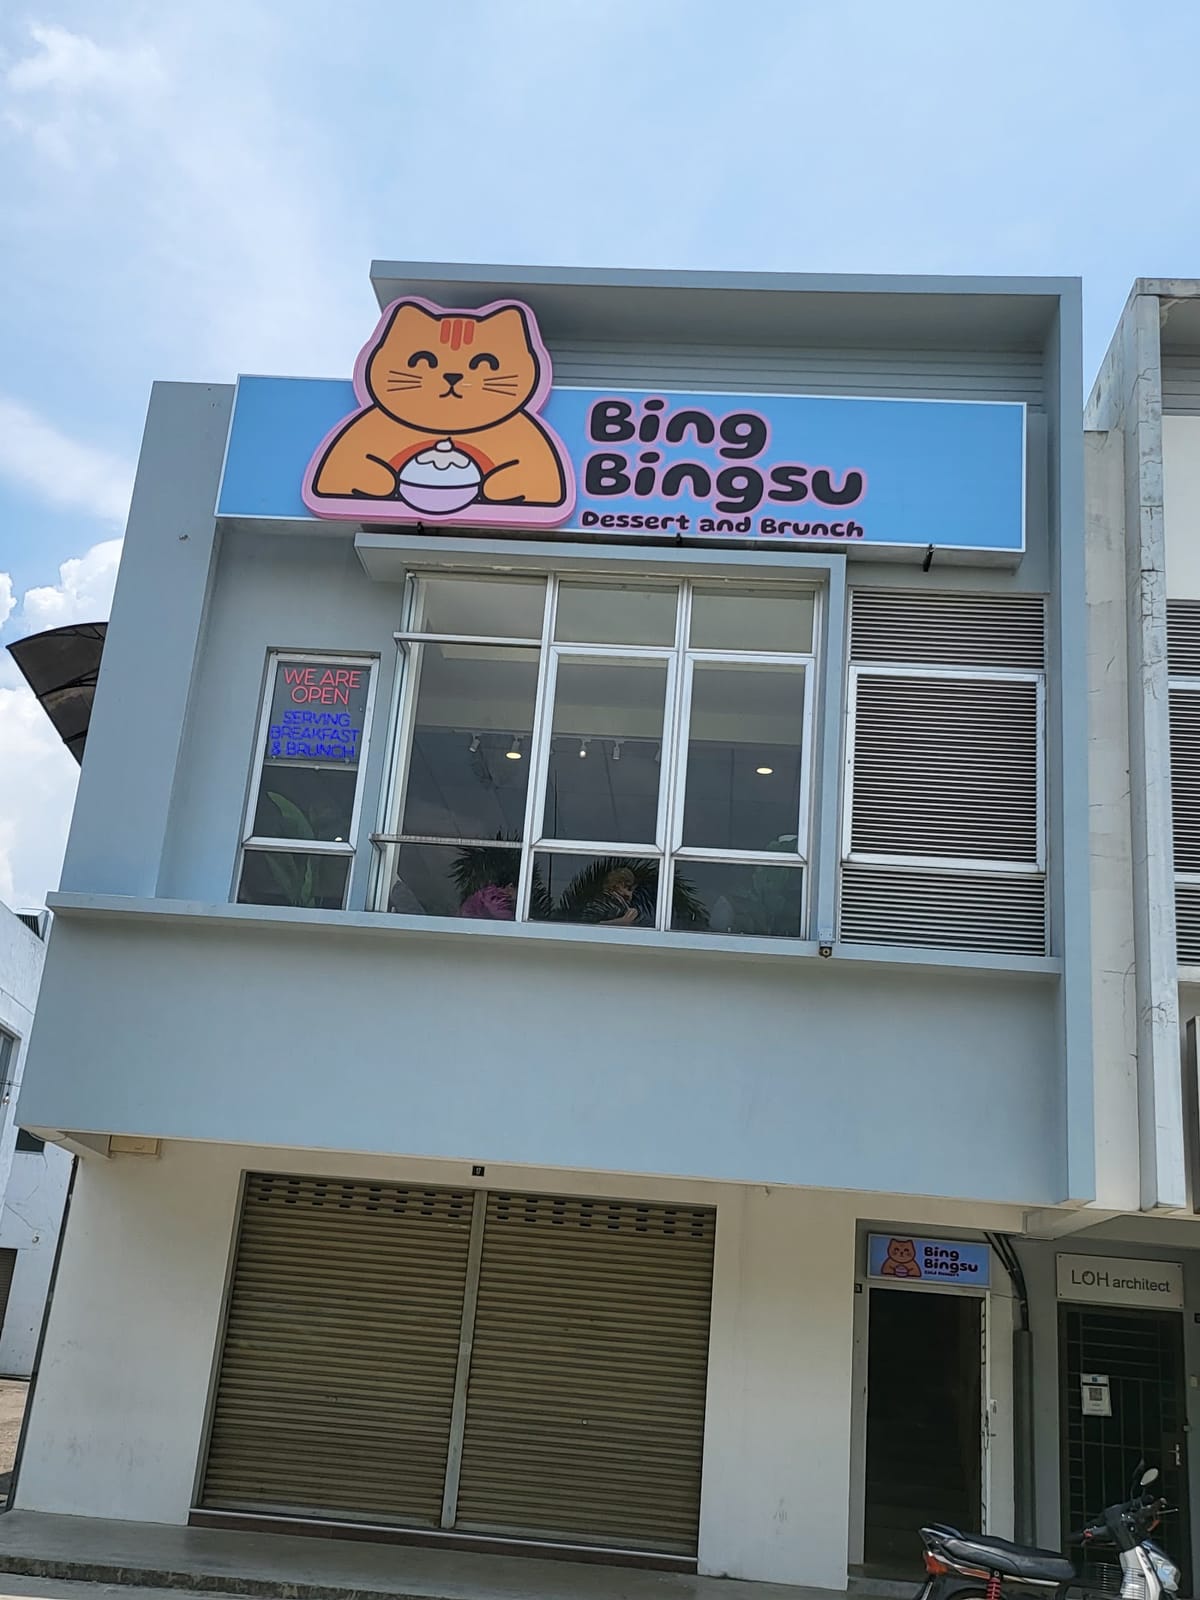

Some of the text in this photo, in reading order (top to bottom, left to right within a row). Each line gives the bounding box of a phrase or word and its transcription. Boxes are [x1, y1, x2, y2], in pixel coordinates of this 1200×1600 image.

[590, 399, 768, 460] Bing
[585, 451, 863, 514] Bingsu
[582, 511, 864, 537] Dessert and Brunch
[284, 668, 362, 688] WE ARE
[291, 685, 350, 705] OPEN
[283, 710, 351, 727] SERVING
[270, 725, 360, 743] BREAKFAST
[272, 741, 355, 758] & BRUNCH
[924, 1246, 960, 1262] Bing
[924, 1258, 979, 1274] Bingsu
[1071, 1269, 1171, 1293] LOH architect
